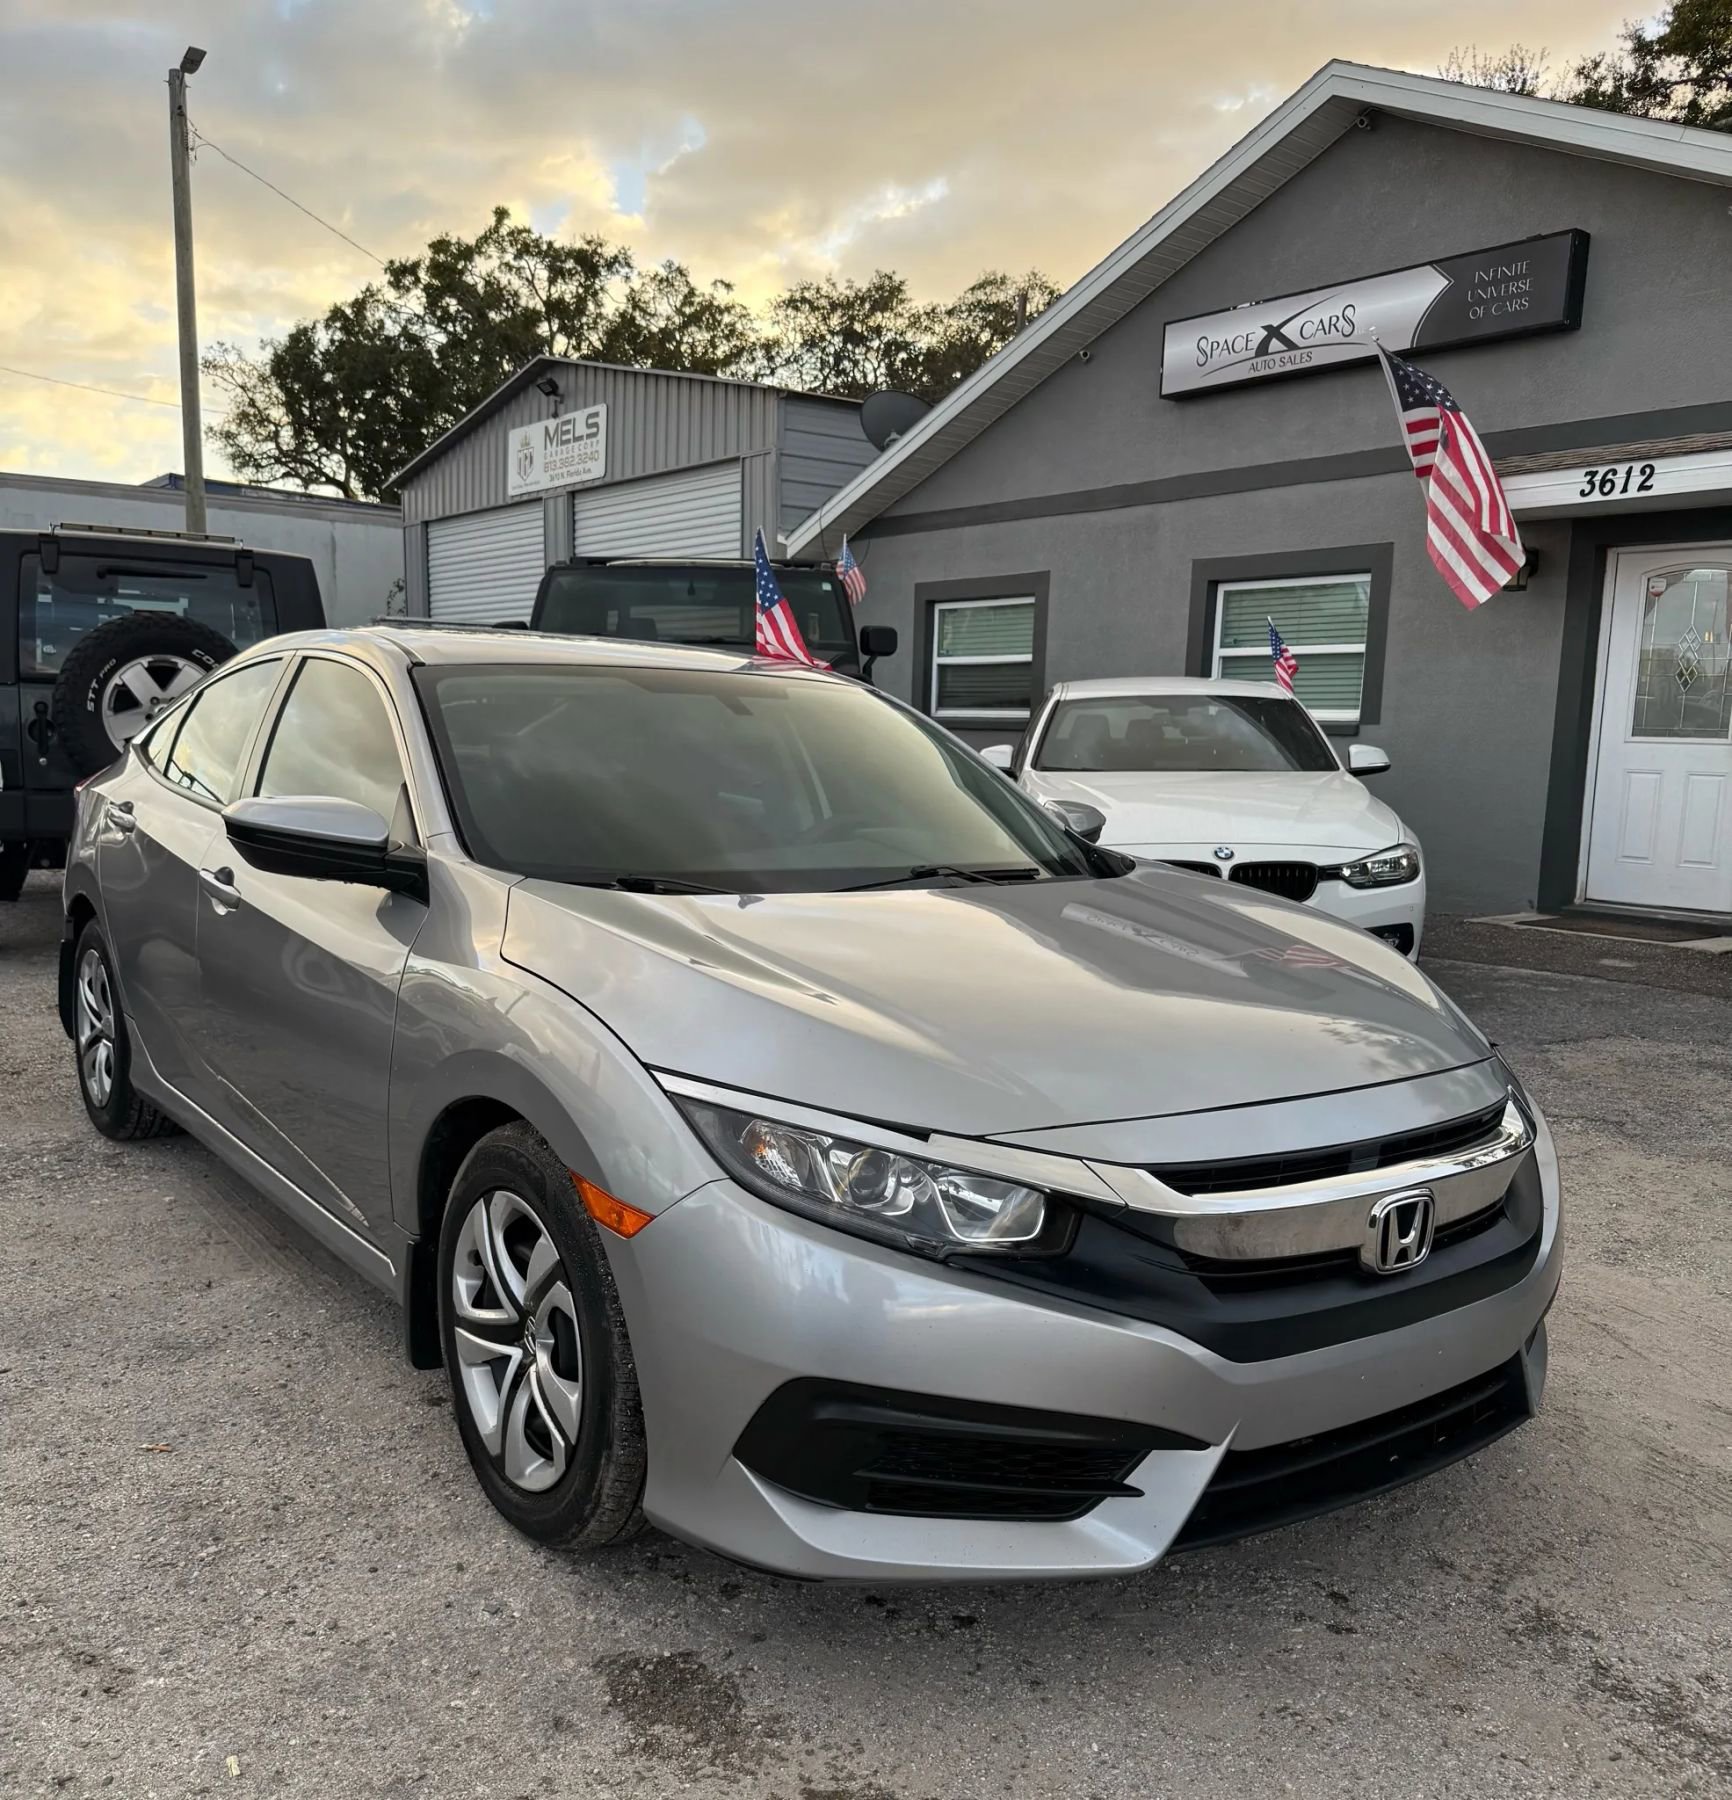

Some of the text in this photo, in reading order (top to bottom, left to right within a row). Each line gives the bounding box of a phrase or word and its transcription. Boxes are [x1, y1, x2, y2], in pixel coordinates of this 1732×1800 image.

[1475, 260, 1531, 283] INFINITE
[1468, 278, 1534, 302] UNIVERSE
[1469, 297, 1529, 319] OF CARS
[1196, 331, 1256, 367] SPACE
[1300, 304, 1356, 340] CARS
[1248, 351, 1313, 373] AUTO SALES
[544, 411, 600, 451] MELS
[1579, 463, 1655, 498] 3612
[86, 658, 117, 713] STT PRO
